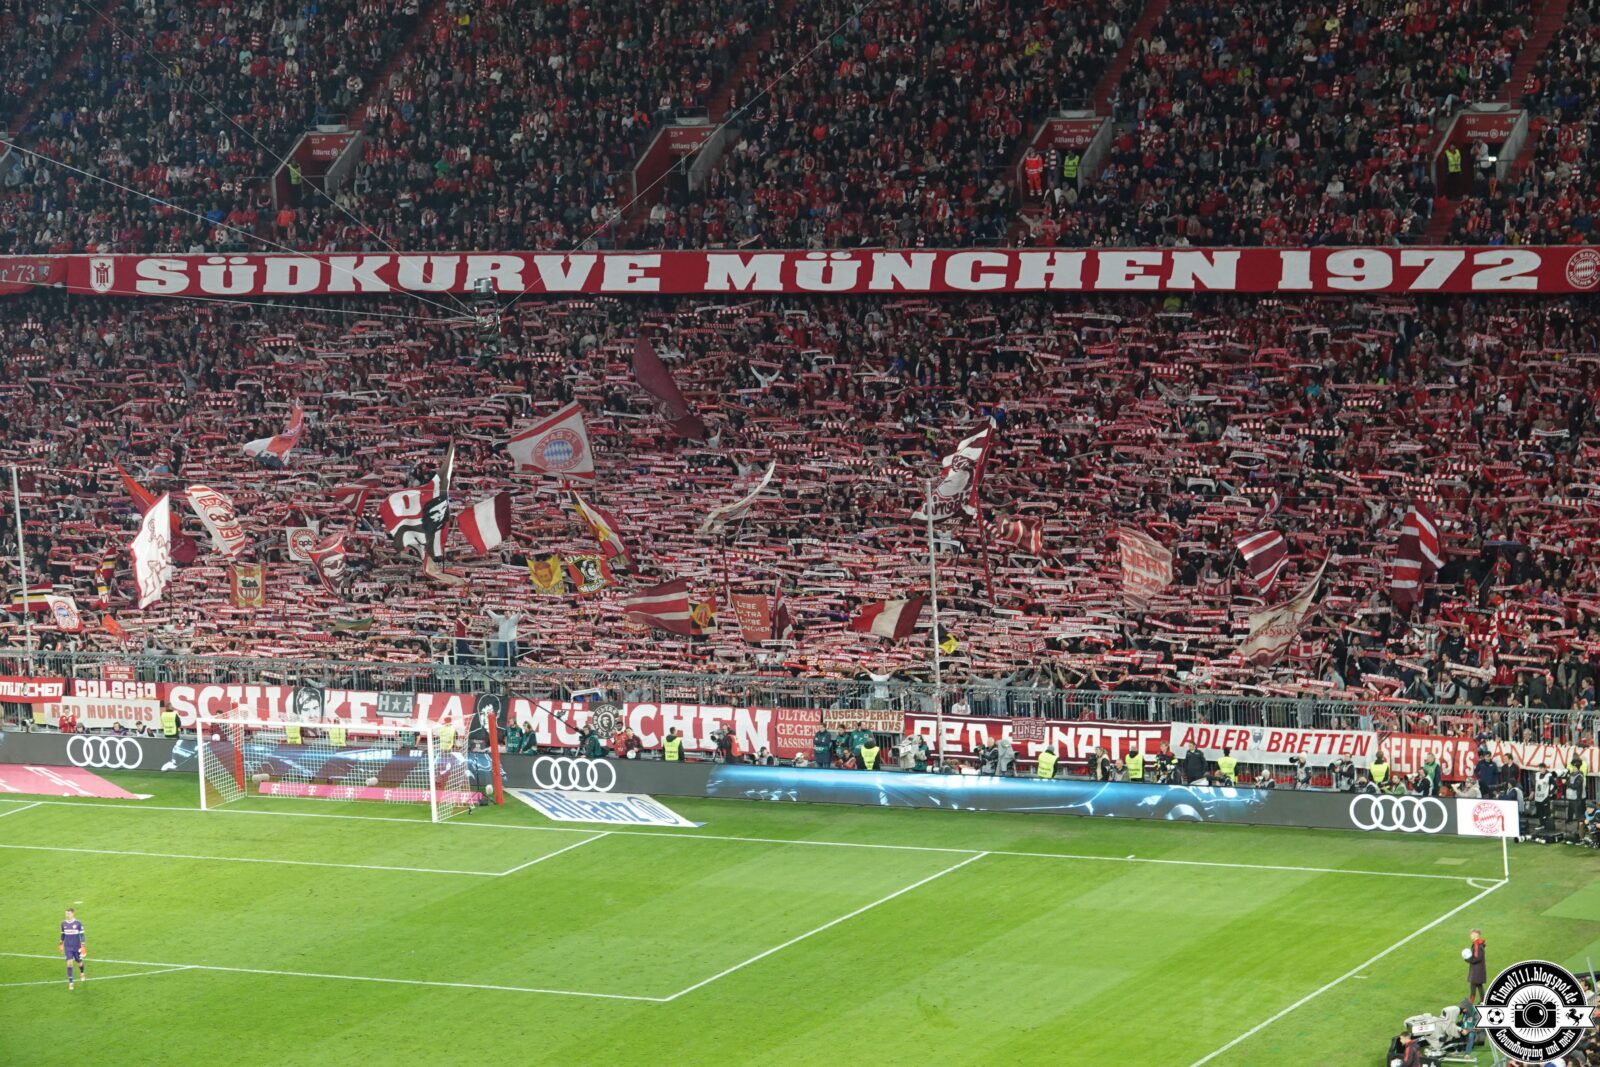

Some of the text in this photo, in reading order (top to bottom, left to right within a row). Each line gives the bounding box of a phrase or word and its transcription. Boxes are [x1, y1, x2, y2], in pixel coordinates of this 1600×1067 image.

[136, 249, 1542, 294] SÜDKURVE MÜNCHEN 1972
[51, 705, 81, 719] RD
[170, 685, 467, 737] SCHIKEIA
[778, 710, 821, 721] ULTRAS
[824, 709, 904, 721] AUSGESPERRTE
[514, 699, 772, 754] MÜCHEN
[777, 724, 821, 737] GEGEN
[881, 722, 902, 732] UNS
[1180, 727, 1371, 757] ADLER BRETTEN
[1381, 737, 1454, 776] SELTERS
[518, 790, 654, 822] Allianz
